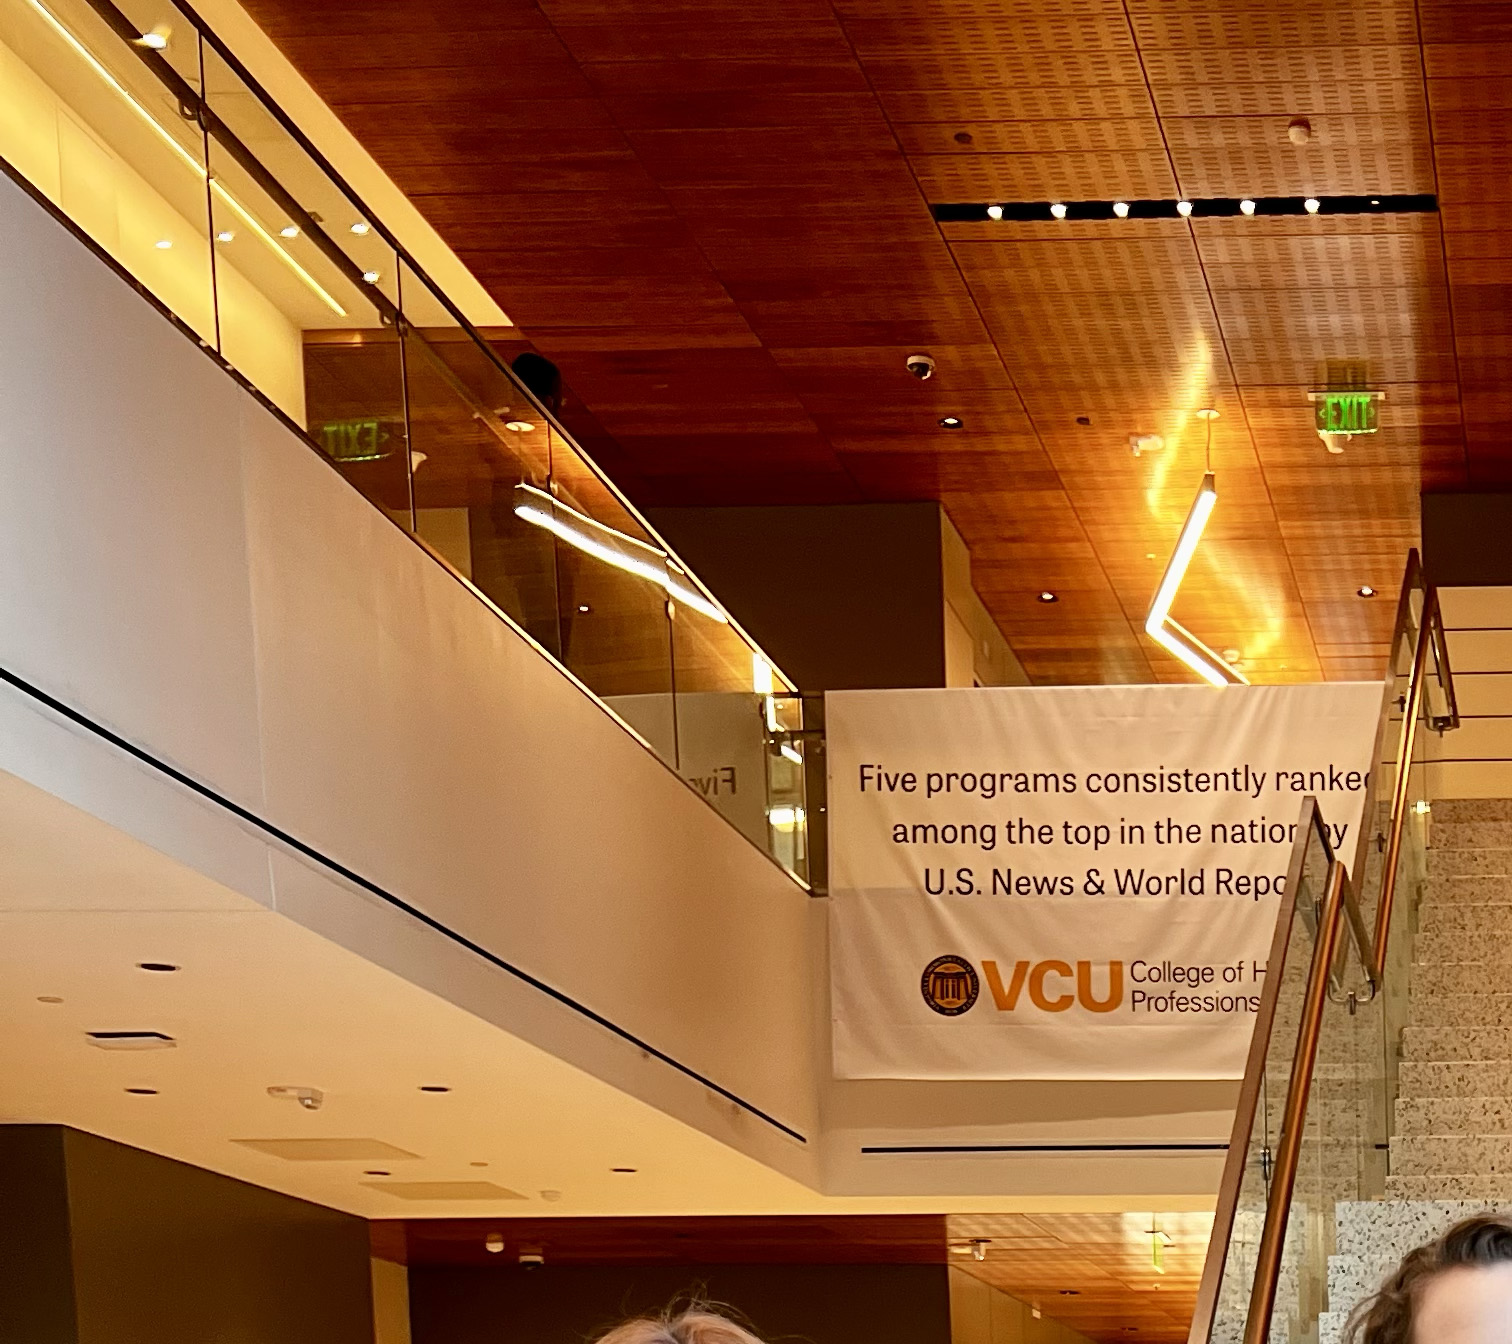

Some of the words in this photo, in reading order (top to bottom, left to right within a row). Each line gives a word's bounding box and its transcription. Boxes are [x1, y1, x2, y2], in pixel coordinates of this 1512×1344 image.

[1326, 397, 1370, 431] EXIT
[859, 764, 917, 793] Five
[926, 772, 1077, 800] programs
[1086, 764, 1267, 799] consistently
[892, 823, 996, 851] among
[1005, 817, 1054, 845] the
[1062, 820, 1111, 851] top
[1120, 817, 1145, 845] in
[1154, 817, 1202, 845] the
[924, 867, 982, 896] U.S.
[992, 868, 1074, 896] News
[1083, 868, 1106, 896] &
[1113, 868, 1205, 896] World
[981, 960, 1123, 1012] VCU
[1130, 960, 1215, 989] College
[1222, 960, 1245, 983] of
[1131, 987, 1260, 1013] Professions
